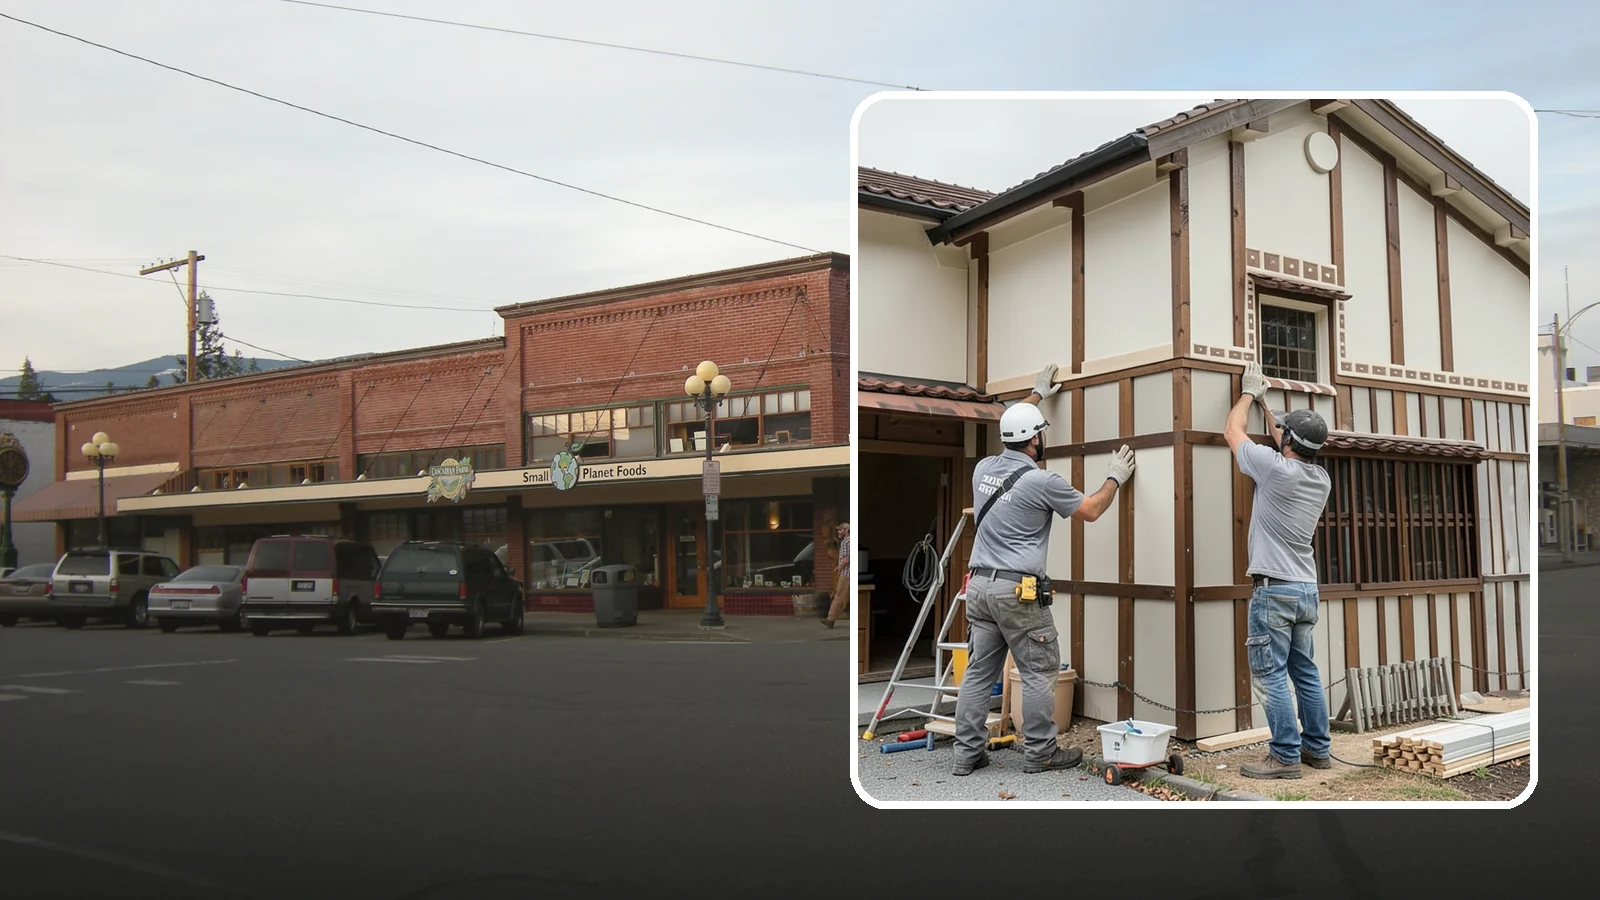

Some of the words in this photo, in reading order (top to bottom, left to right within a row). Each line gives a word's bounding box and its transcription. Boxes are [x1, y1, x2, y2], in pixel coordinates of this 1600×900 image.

[523, 471, 549, 482] Small
[583, 467, 614, 479] Planet
[617, 464, 647, 476] Foods
